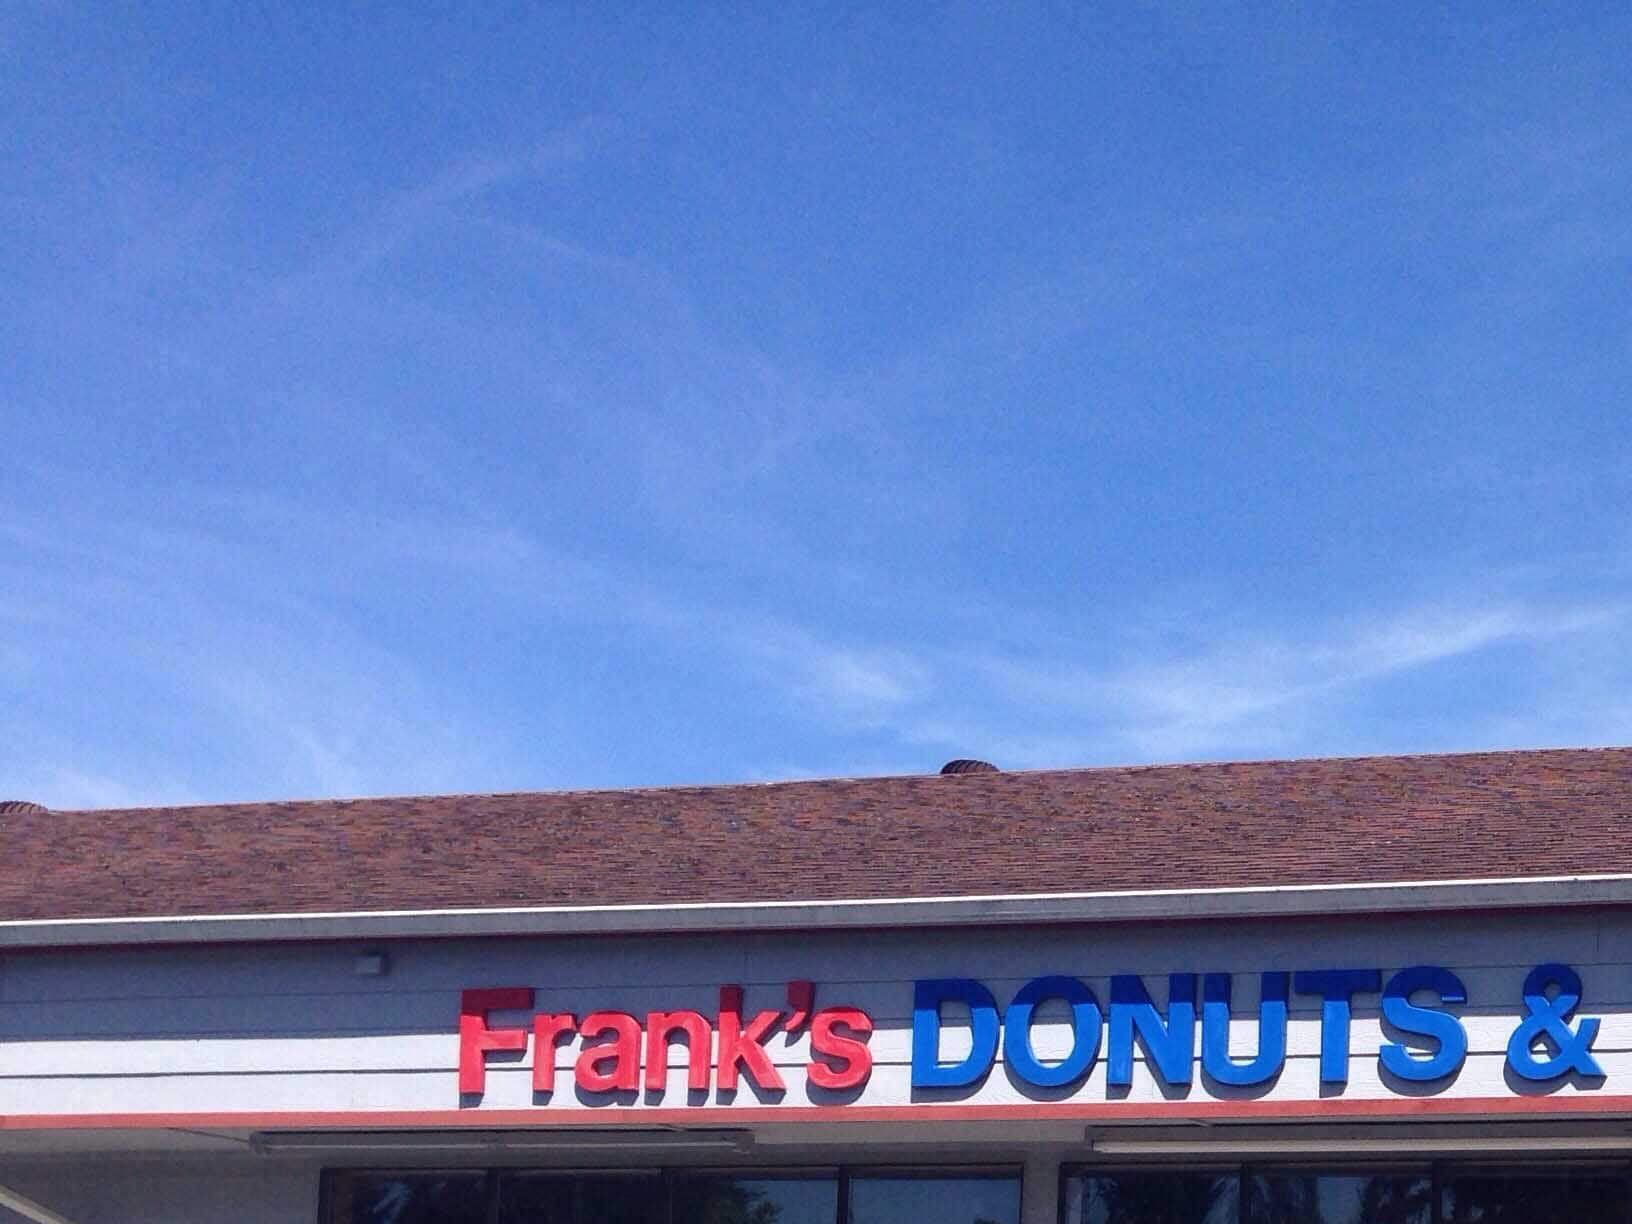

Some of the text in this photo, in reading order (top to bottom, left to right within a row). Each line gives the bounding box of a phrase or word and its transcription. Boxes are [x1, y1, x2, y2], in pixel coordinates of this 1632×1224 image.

[458, 981, 872, 1095] Frank's
[911, 965, 1467, 1088] DONUTS
[1504, 963, 1606, 1079] &
